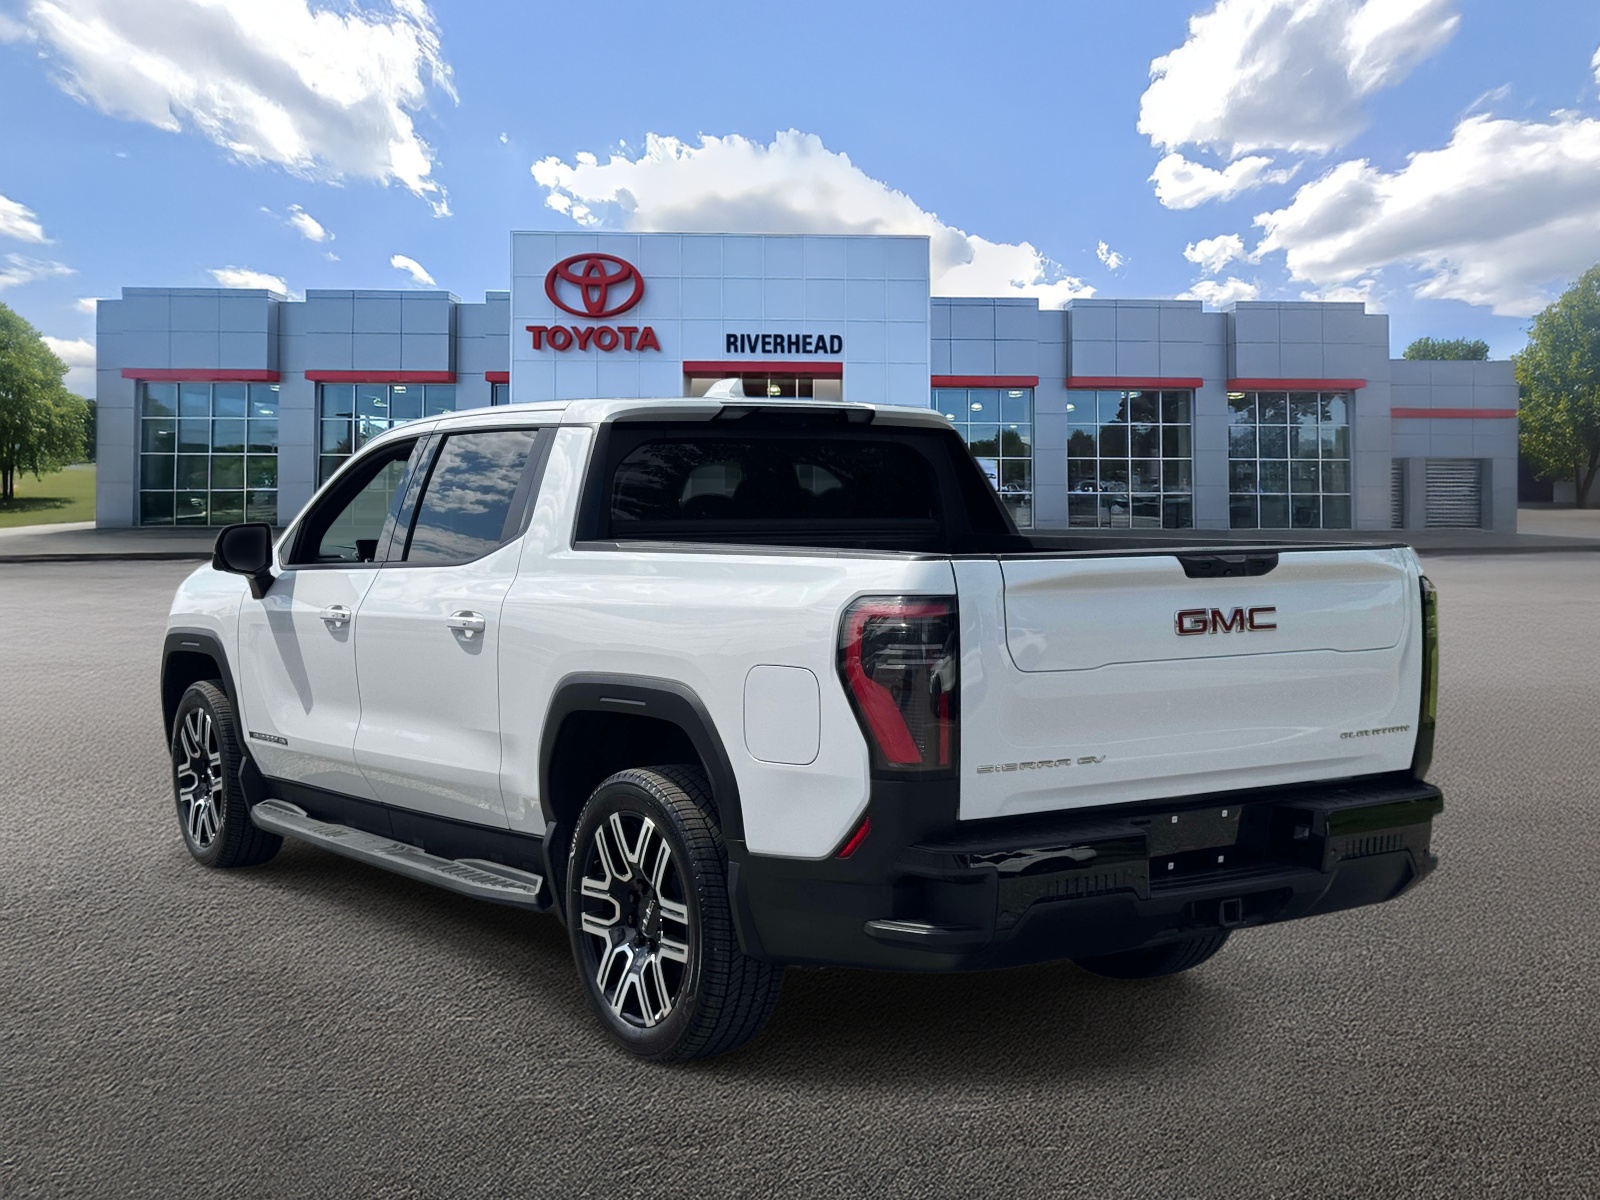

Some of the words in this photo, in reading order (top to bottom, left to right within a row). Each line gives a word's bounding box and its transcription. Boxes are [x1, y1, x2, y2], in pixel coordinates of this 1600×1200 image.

[526, 325, 661, 351] TOYOTA
[726, 333, 843, 354] RIVERHEAD
[1174, 605, 1277, 636] GMC
[977, 758, 1072, 774] SIERRA
[1077, 755, 1106, 765] EV
